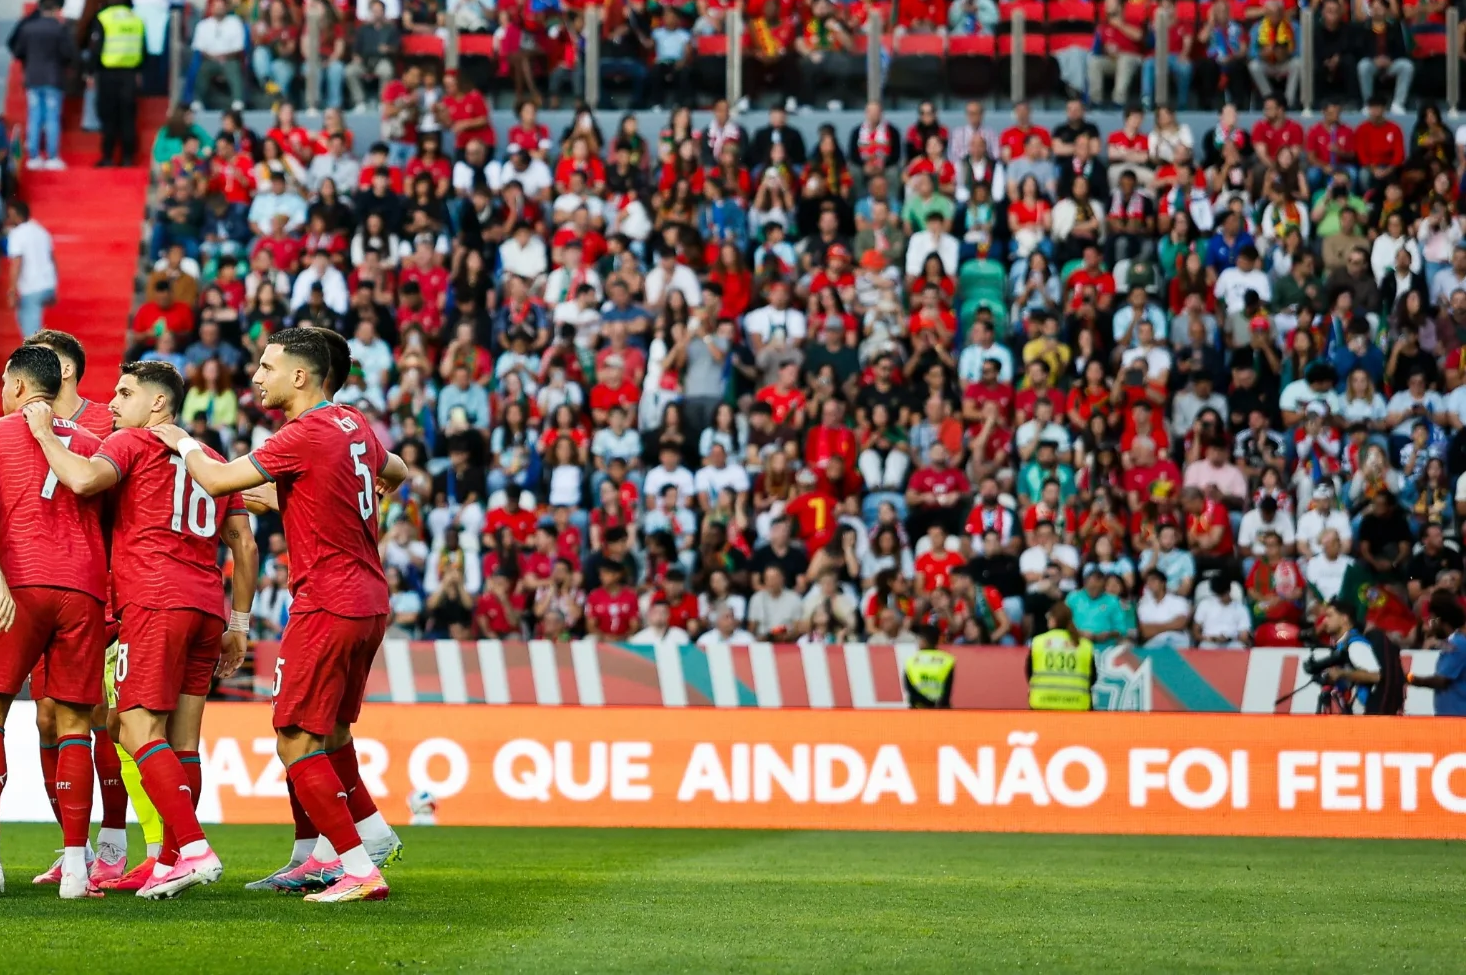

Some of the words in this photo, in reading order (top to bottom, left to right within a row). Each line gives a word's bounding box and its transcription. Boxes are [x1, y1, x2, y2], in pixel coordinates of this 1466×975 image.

[169, 454, 216, 538] 18
[350, 441, 373, 521] 5
[272, 657, 285, 697] 5
[407, 737, 469, 798] O
[492, 737, 653, 802] QUE
[676, 741, 918, 804] AINDA
[937, 730, 1108, 807] NÃO
[1128, 746, 1249, 810] FOI
